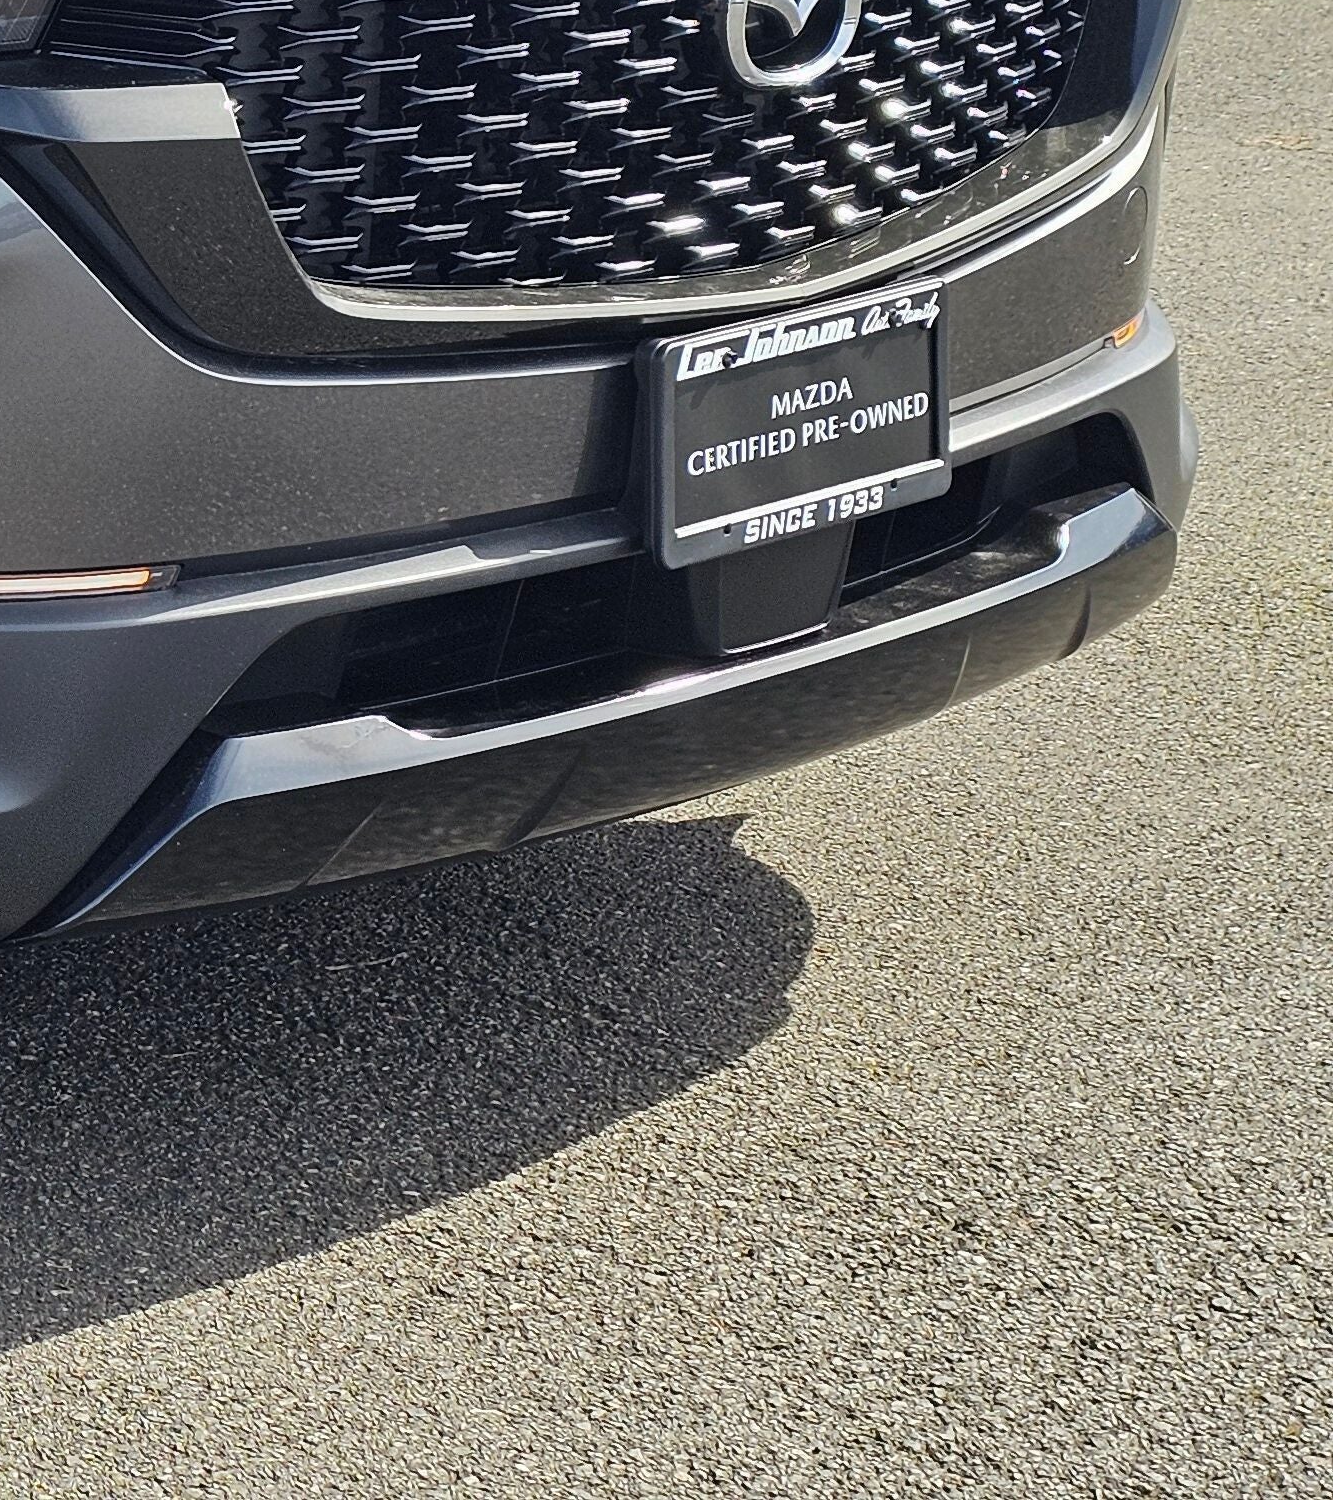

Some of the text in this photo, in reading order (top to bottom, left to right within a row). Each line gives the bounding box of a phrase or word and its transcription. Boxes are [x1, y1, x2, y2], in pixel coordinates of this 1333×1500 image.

[731, 315, 857, 367] Johnson
[771, 377, 854, 419] MAZDA
[687, 392, 930, 477] CERTIFIED PRE-OWNED
[744, 486, 884, 545] SINCE 1933
